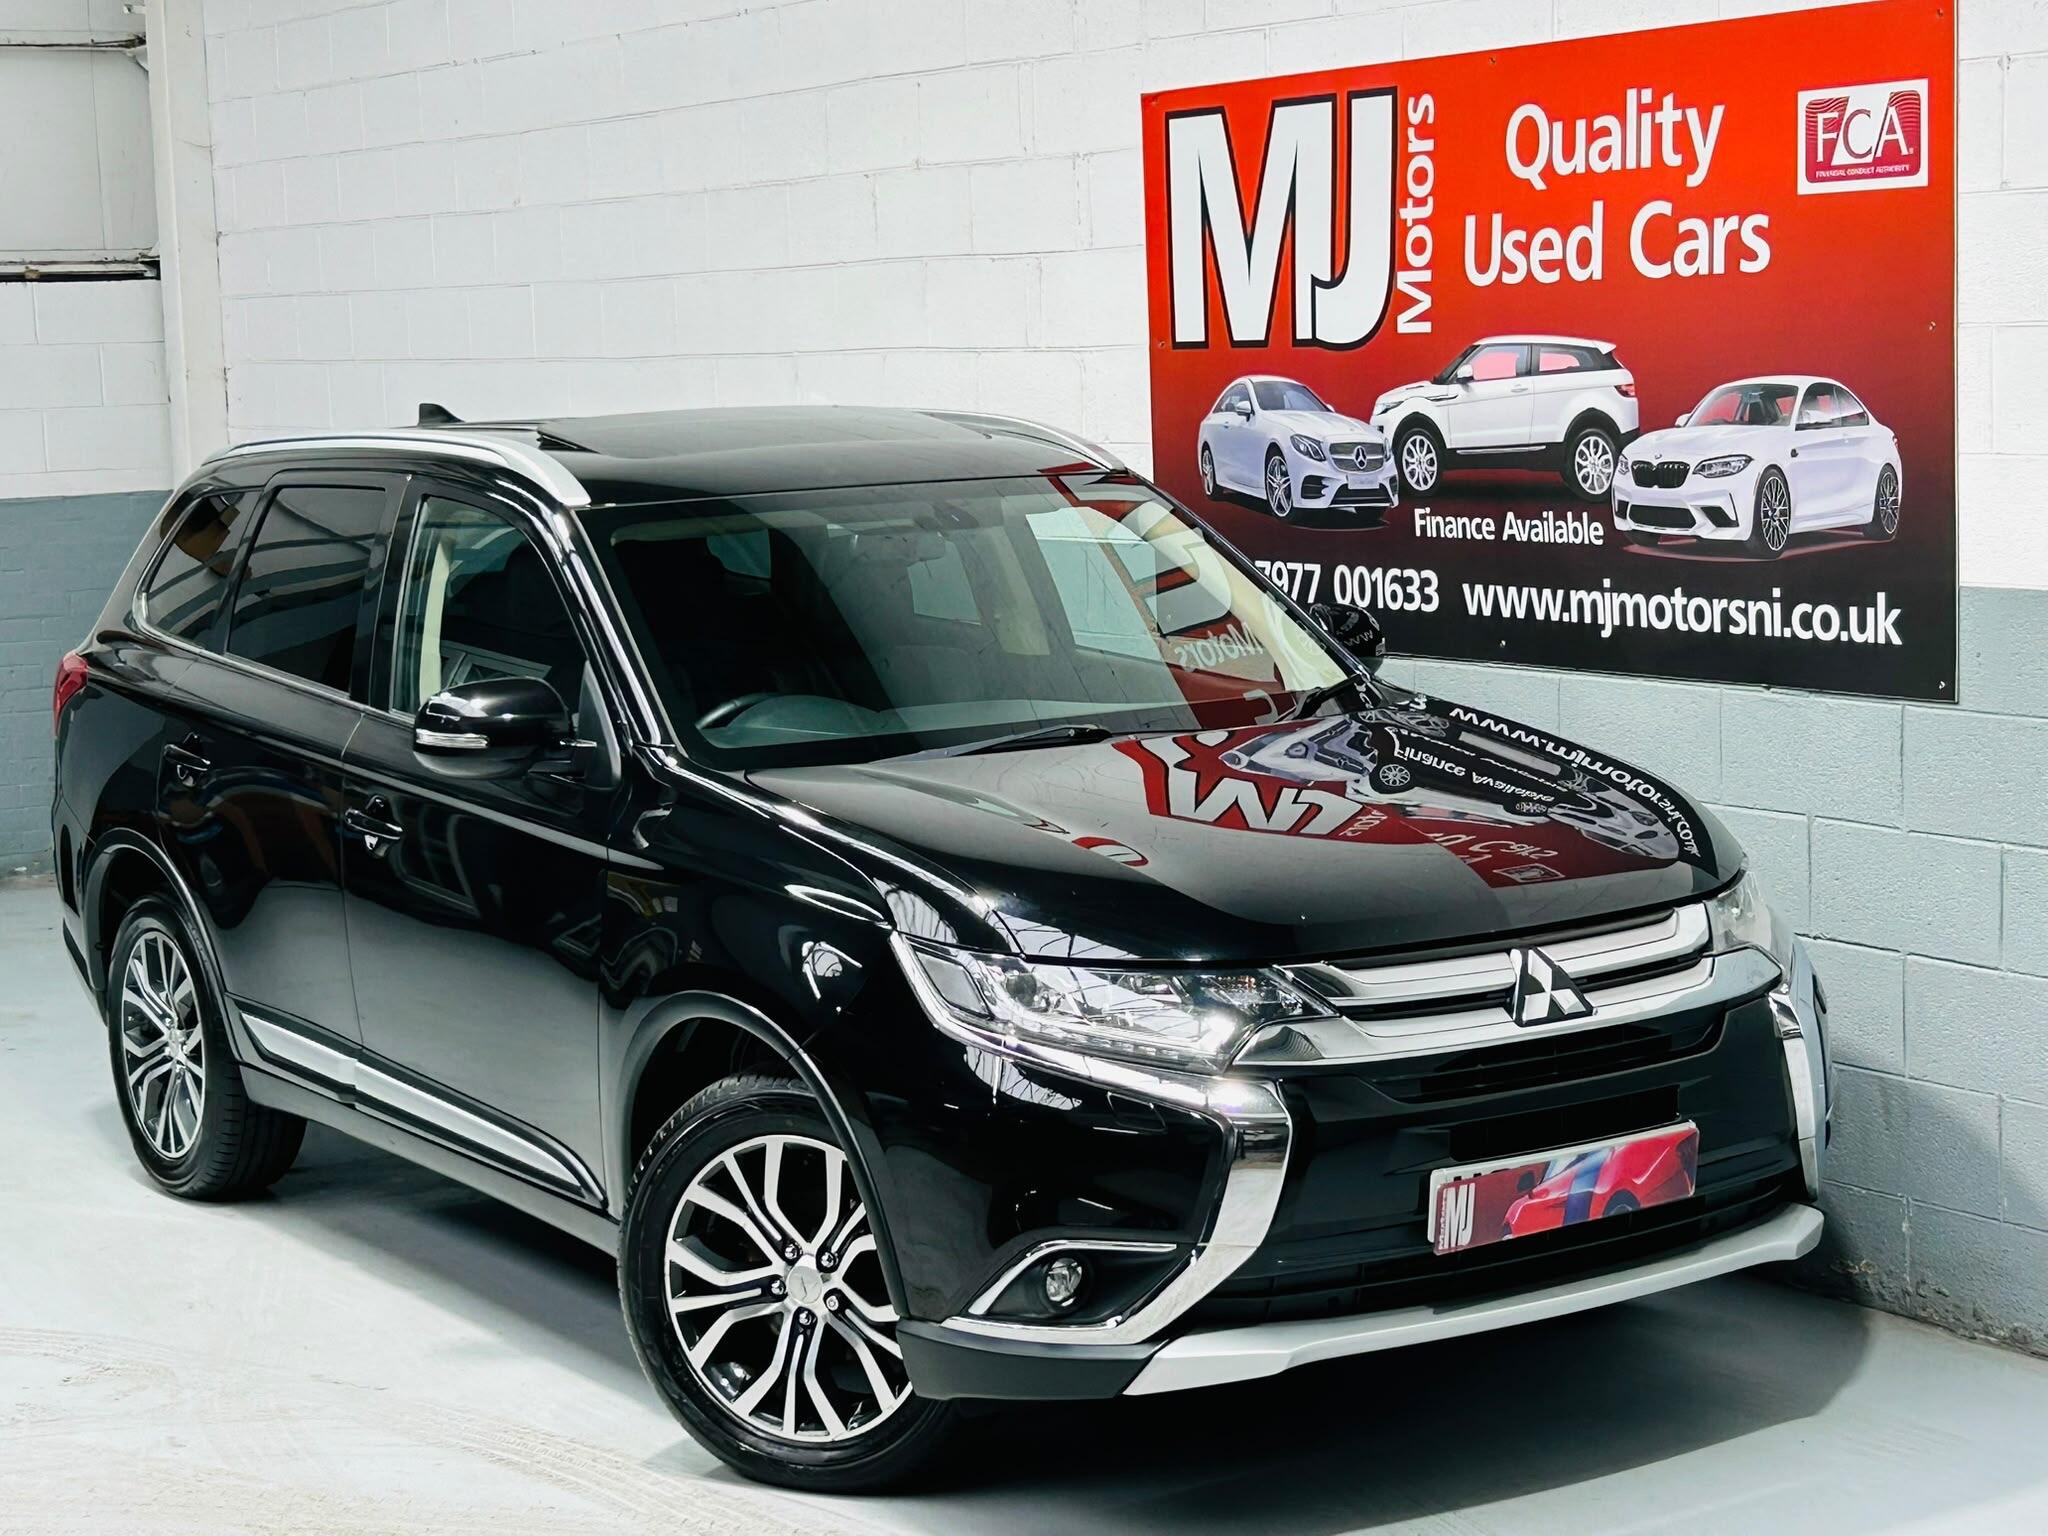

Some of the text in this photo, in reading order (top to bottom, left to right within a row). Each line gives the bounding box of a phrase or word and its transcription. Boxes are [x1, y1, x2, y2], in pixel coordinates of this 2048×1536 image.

[1505, 87, 1725, 190] Quality
[1165, 86, 1398, 351] MJ
[1396, 92, 1435, 334] Motors
[1463, 200, 1771, 287] Used Cars
[1413, 507, 1604, 546] Finance Available
[1333, 564, 1440, 613] 001633
[1462, 578, 1902, 645] www.mjmotorsni.co.uk
[1444, 1182, 1475, 1249] MJ
